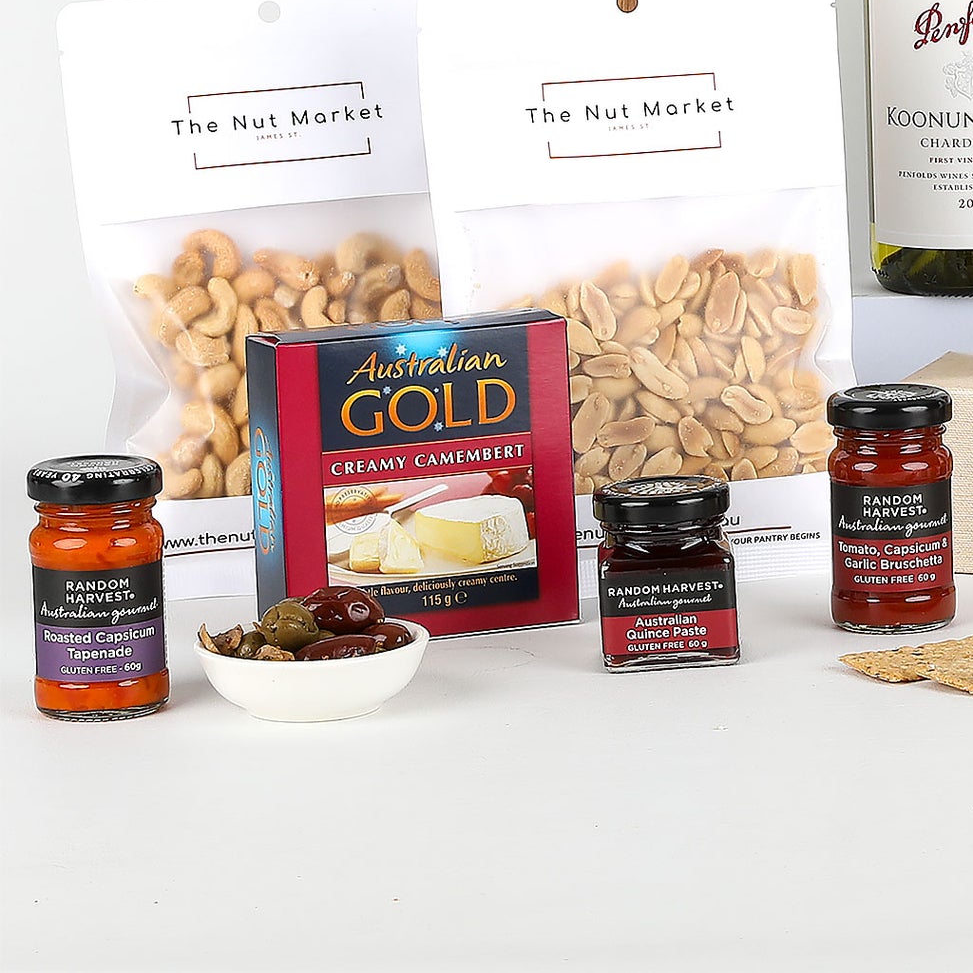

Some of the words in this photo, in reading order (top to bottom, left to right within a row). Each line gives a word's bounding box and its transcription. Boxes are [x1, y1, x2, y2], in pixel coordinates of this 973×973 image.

[525, 108, 571, 124] The
[585, 104, 629, 121] Nut
[644, 97, 734, 117] Market
[171, 119, 218, 136] The
[233, 114, 278, 131] Nut
[291, 104, 383, 126] Market
[256, 132, 284, 141] JAMES
[928, 156, 954, 164] FIRST
[898, 170, 938, 180] PENFOLDS
[940, 172, 969, 180] WINES
[347, 343, 507, 385] Australian
[340, 378, 517, 437] GOLD
[330, 456, 406, 476] CREAMY
[414, 444, 525, 468] CAMEMBERT
[61, 472, 82, 483] 40
[863, 494, 923, 506] RANDOM
[838, 515, 904, 533] Australian
[905, 513, 948, 538] gourmet
[754, 534, 788, 544] PANTRY
[790, 531, 821, 541] BEGINS
[838, 541, 881, 557] Tomato,
[883, 540, 941, 557] Capsicum
[941, 537, 949, 549] &
[844, 557, 877, 570] Garlic
[880, 554, 943, 570] Bruschetta
[66, 578, 130, 591] RANDOM
[381, 585, 411, 596] flavour,
[412, 578, 455, 593] deliciously
[457, 576, 488, 588] creamy
[489, 573, 518, 583] centre.
[854, 576, 888, 585] GLUTEN
[890, 574, 914, 584] FREE
[608, 583, 660, 598] RANDOM
[422, 594, 443, 607] 115
[444, 595, 451, 608] g
[618, 596, 672, 610] Australian
[672, 593, 713, 610] gourmet
[40, 601, 109, 619] Australian
[111, 598, 159, 625] gourmet
[635, 614, 698, 628] Australian
[43, 629, 92, 645] Roasted
[95, 626, 155, 646] Capsicum
[626, 628, 670, 641] Quince
[673, 626, 707, 638] Paste
[627, 642, 662, 652] GLUTEN
[663, 641, 685, 650] FREE
[67, 646, 133, 663] Tapenade
[60, 666, 94, 675] GLUTEN
[95, 665, 118, 674] FREE
[124, 662, 142, 673] 60g
